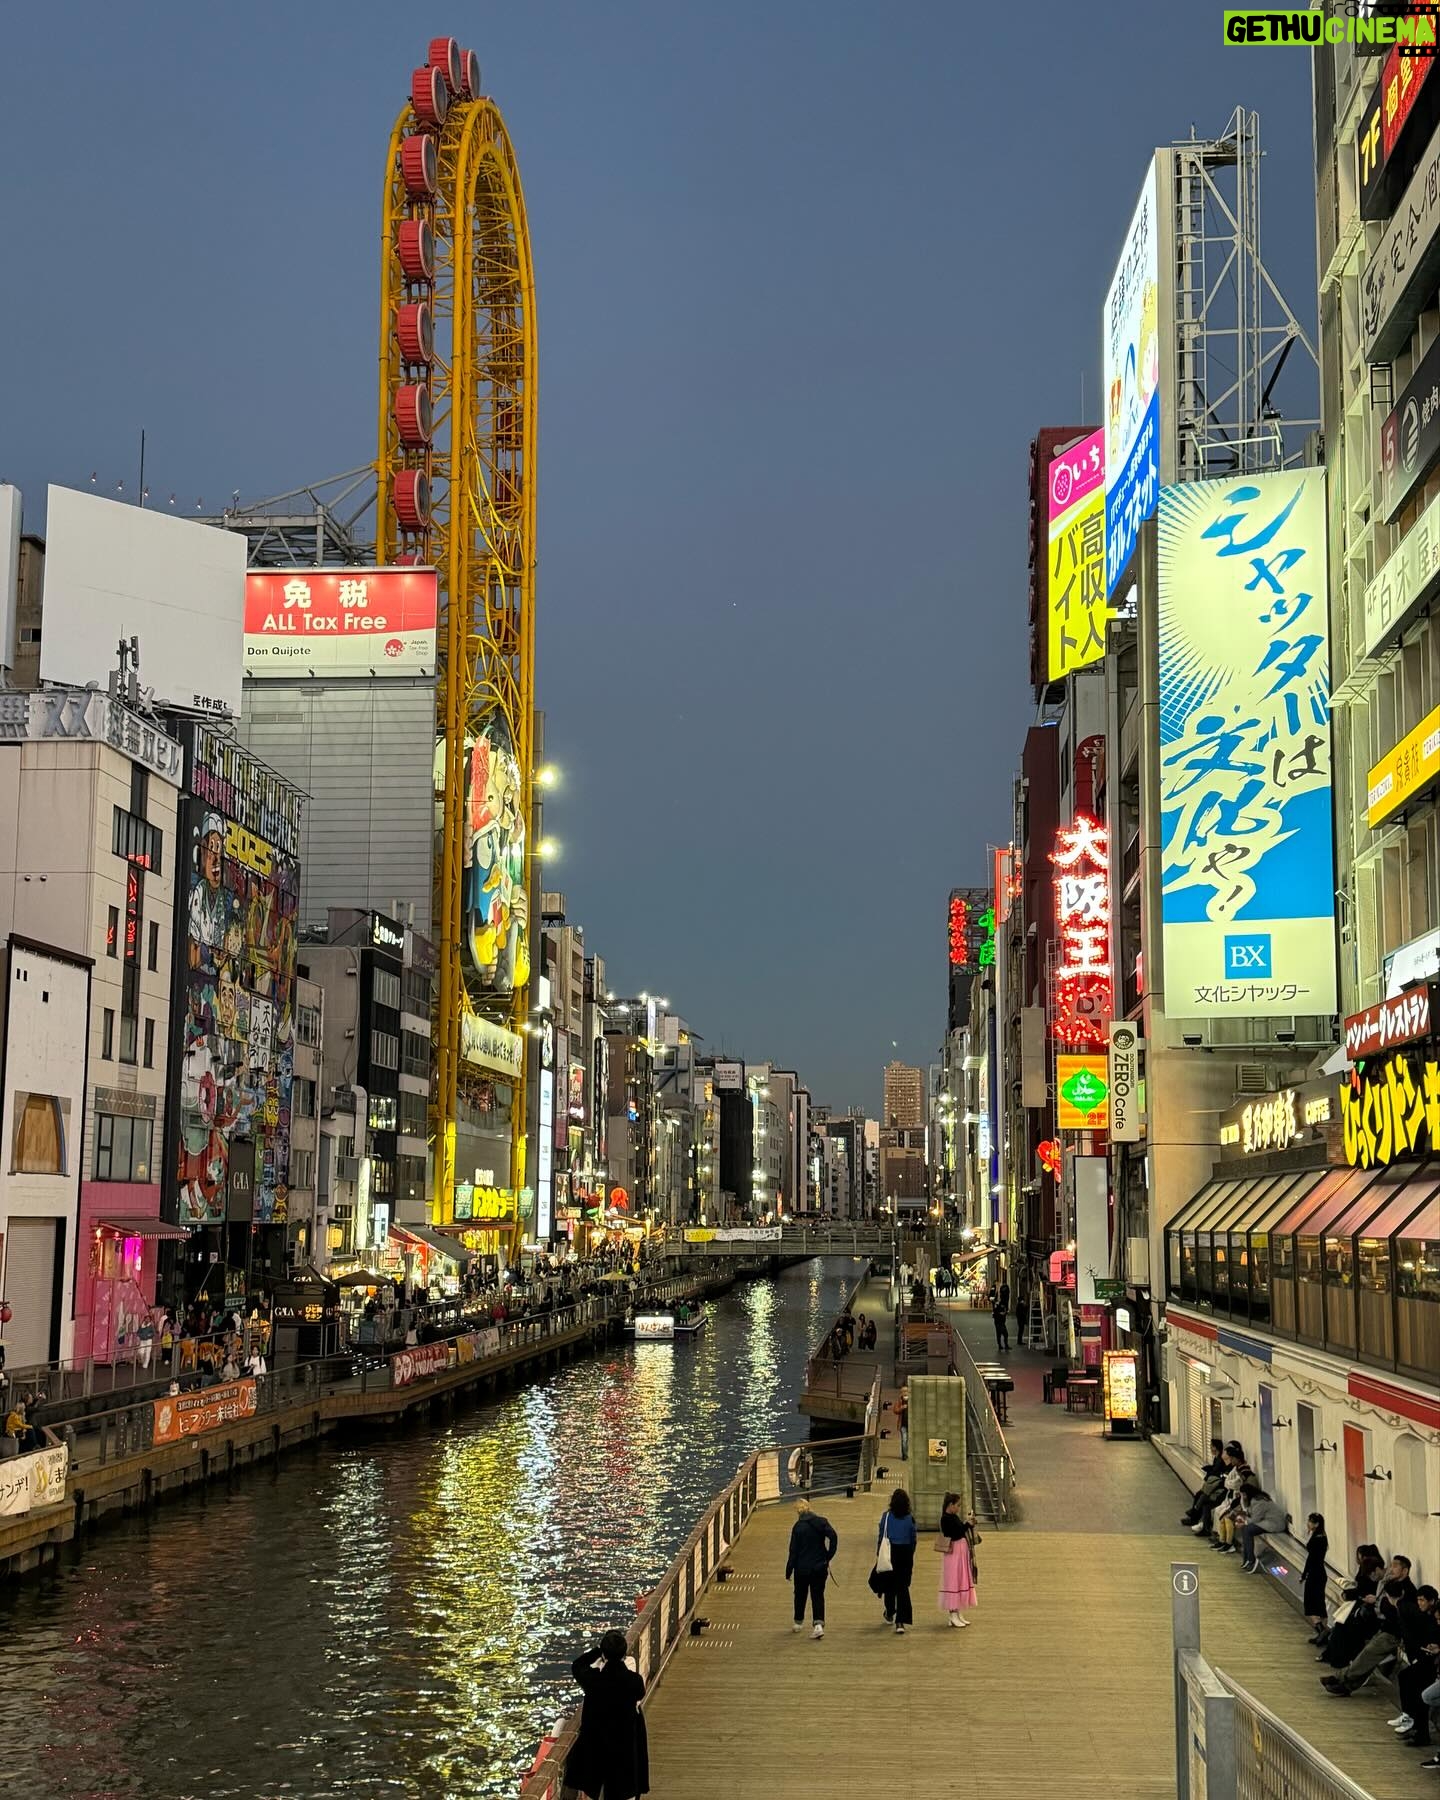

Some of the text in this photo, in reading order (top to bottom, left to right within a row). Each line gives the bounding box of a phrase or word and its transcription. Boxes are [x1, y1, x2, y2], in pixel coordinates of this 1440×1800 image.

[1361, 106, 1380, 187] 7F
[1391, 160, 1440, 288] 完全個
[1385, 425, 1395, 509] 5F
[1108, 448, 1158, 588] ガルフネット
[283, 579, 368, 608] 免税
[1054, 524, 1079, 671] バイト
[1080, 508, 1105, 660] 高収入
[1367, 583, 1378, 619] 4F
[1381, 527, 1430, 631] 白木屋
[247, 646, 311, 657] Don Quijote
[262, 612, 388, 631] ALL Tax Free
[225, 820, 273, 880] 2025
[1230, 945, 1266, 968] BX
[1346, 991, 1429, 1051] ハンバーグレストラン
[1114, 1053, 1130, 1097] ZERO
[1087, 1112, 1107, 1125] 2F
